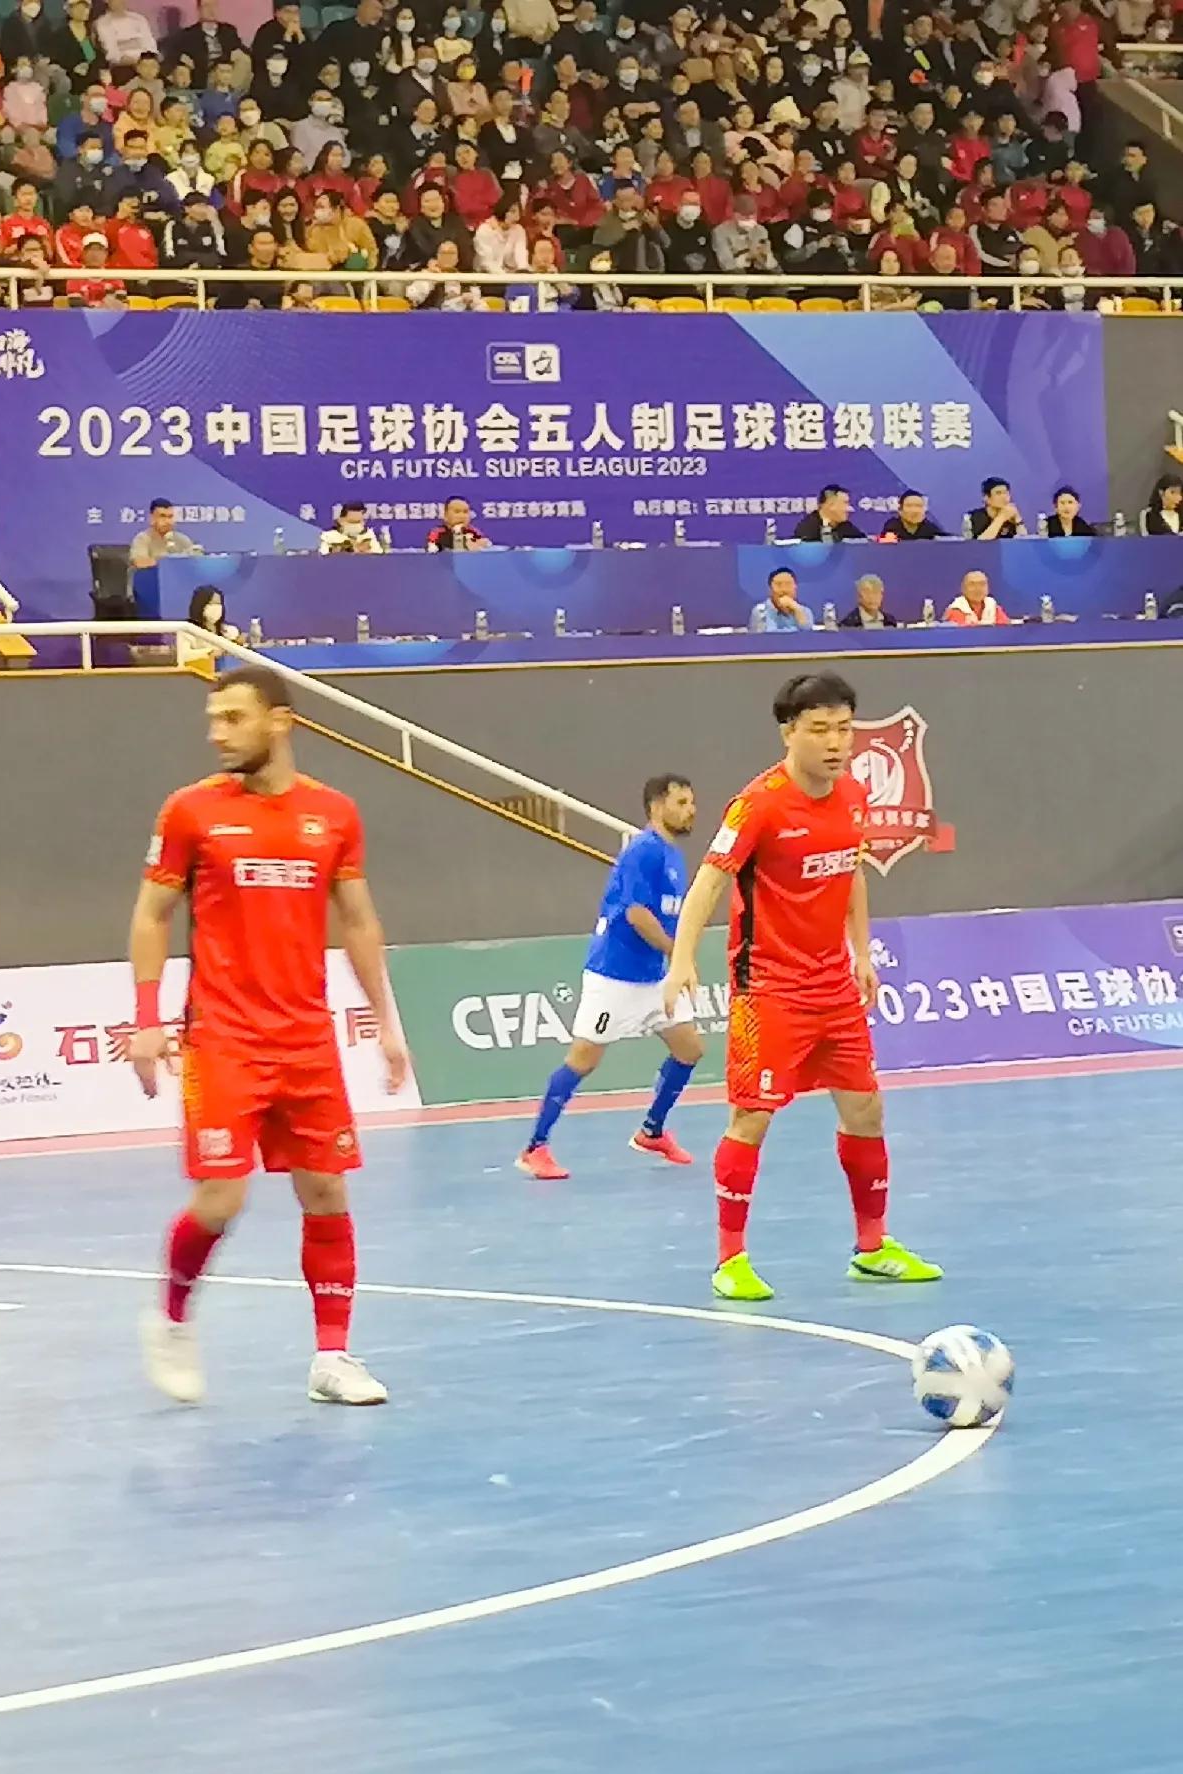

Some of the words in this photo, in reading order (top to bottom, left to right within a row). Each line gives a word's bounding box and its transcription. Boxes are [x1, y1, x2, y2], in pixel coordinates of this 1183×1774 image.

[37, 401, 973, 457] 2023中国足球协会五人制足球超级联赛
[340, 459, 386, 479] CFA
[391, 458, 479, 478] FUTSAL
[485, 458, 561, 478] SUPER
[566, 457, 654, 477] LEAGUE
[657, 456, 707, 476] 2023
[451, 991, 575, 1051] CFA
[867, 964, 1183, 1027] 023中国足球协
[1067, 1017, 1110, 1037] CFA
